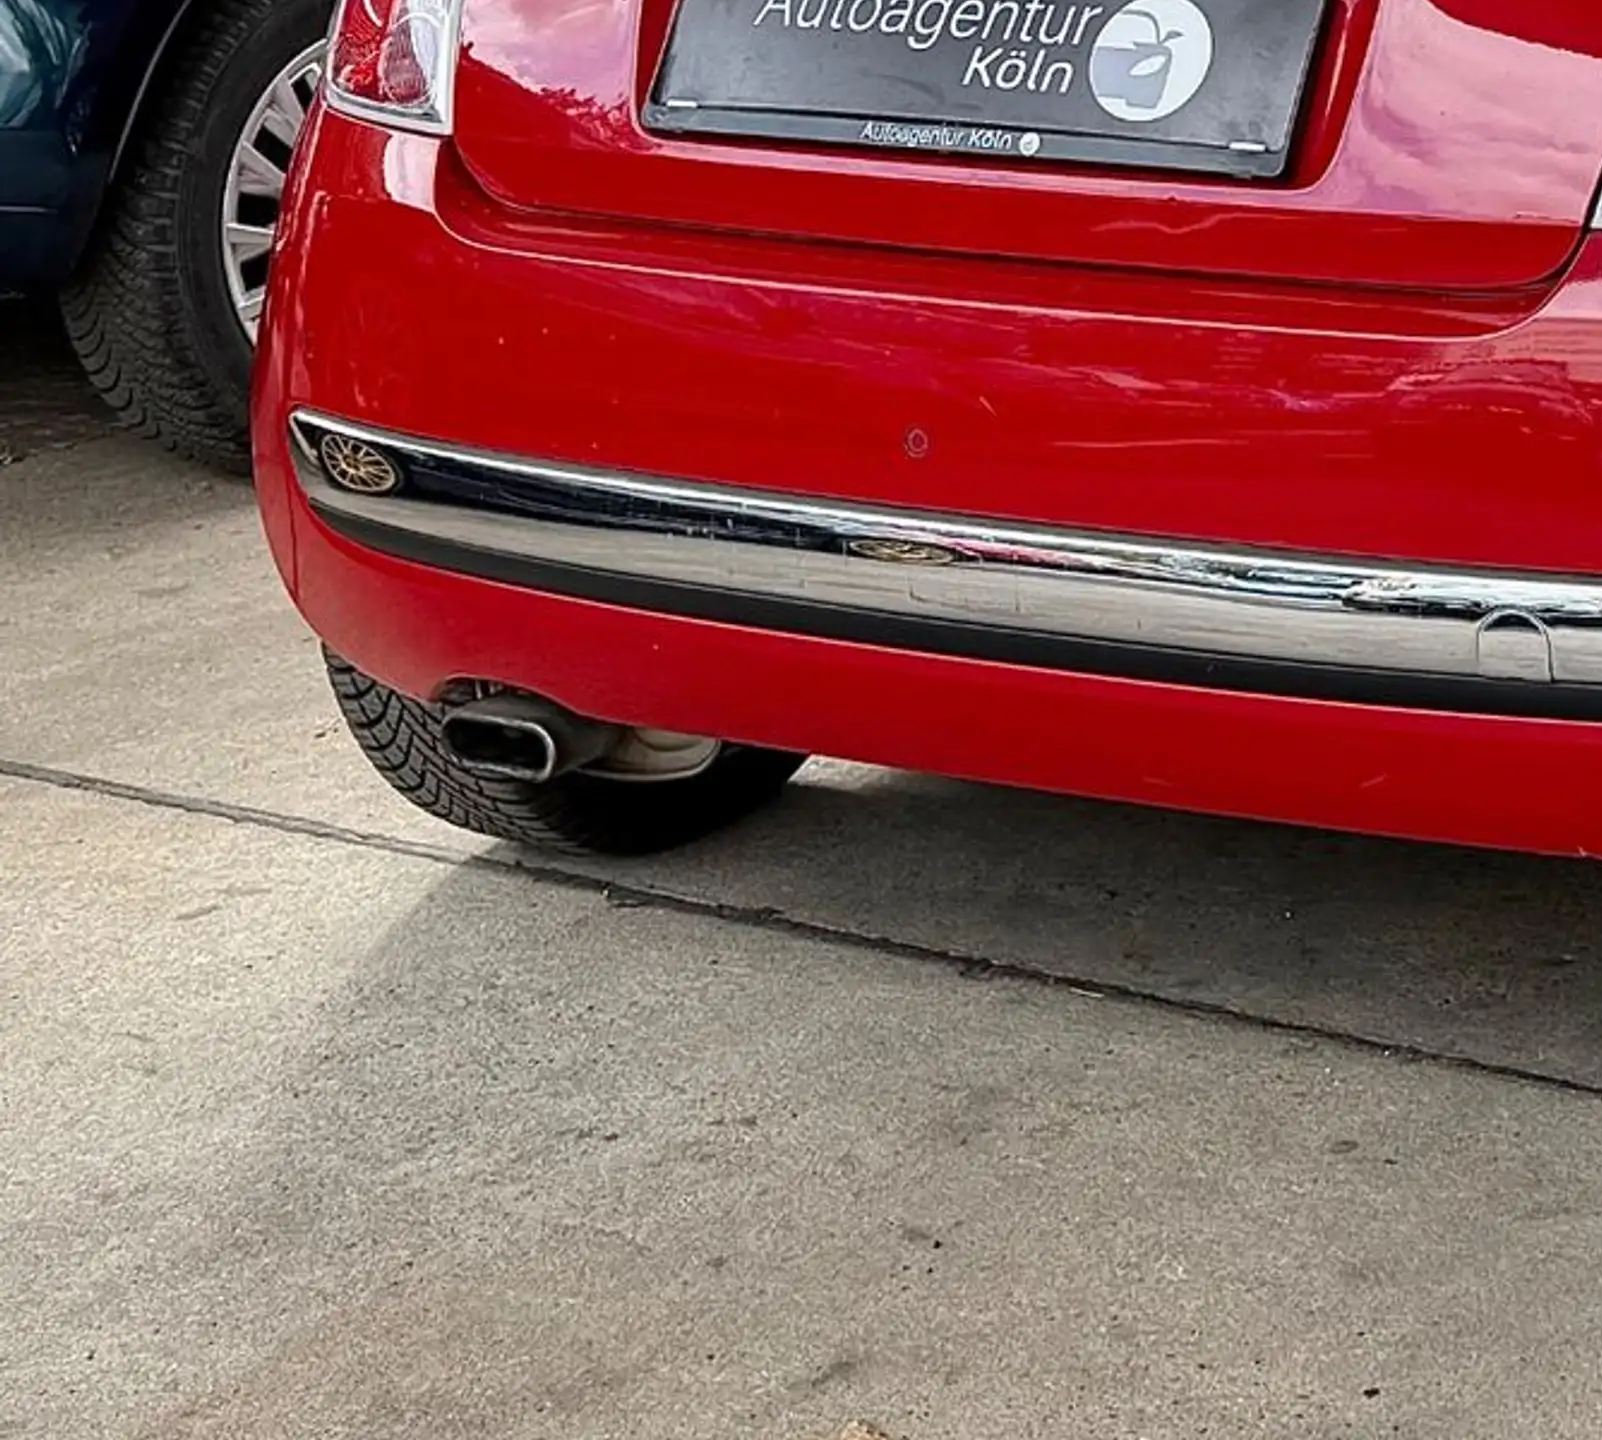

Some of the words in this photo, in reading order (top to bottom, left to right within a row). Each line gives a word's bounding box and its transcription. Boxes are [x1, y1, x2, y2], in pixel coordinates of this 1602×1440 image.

[962, 45, 1075, 94] Köln
[860, 121, 965, 148] Autoagentur
[967, 128, 1013, 150] Köln
